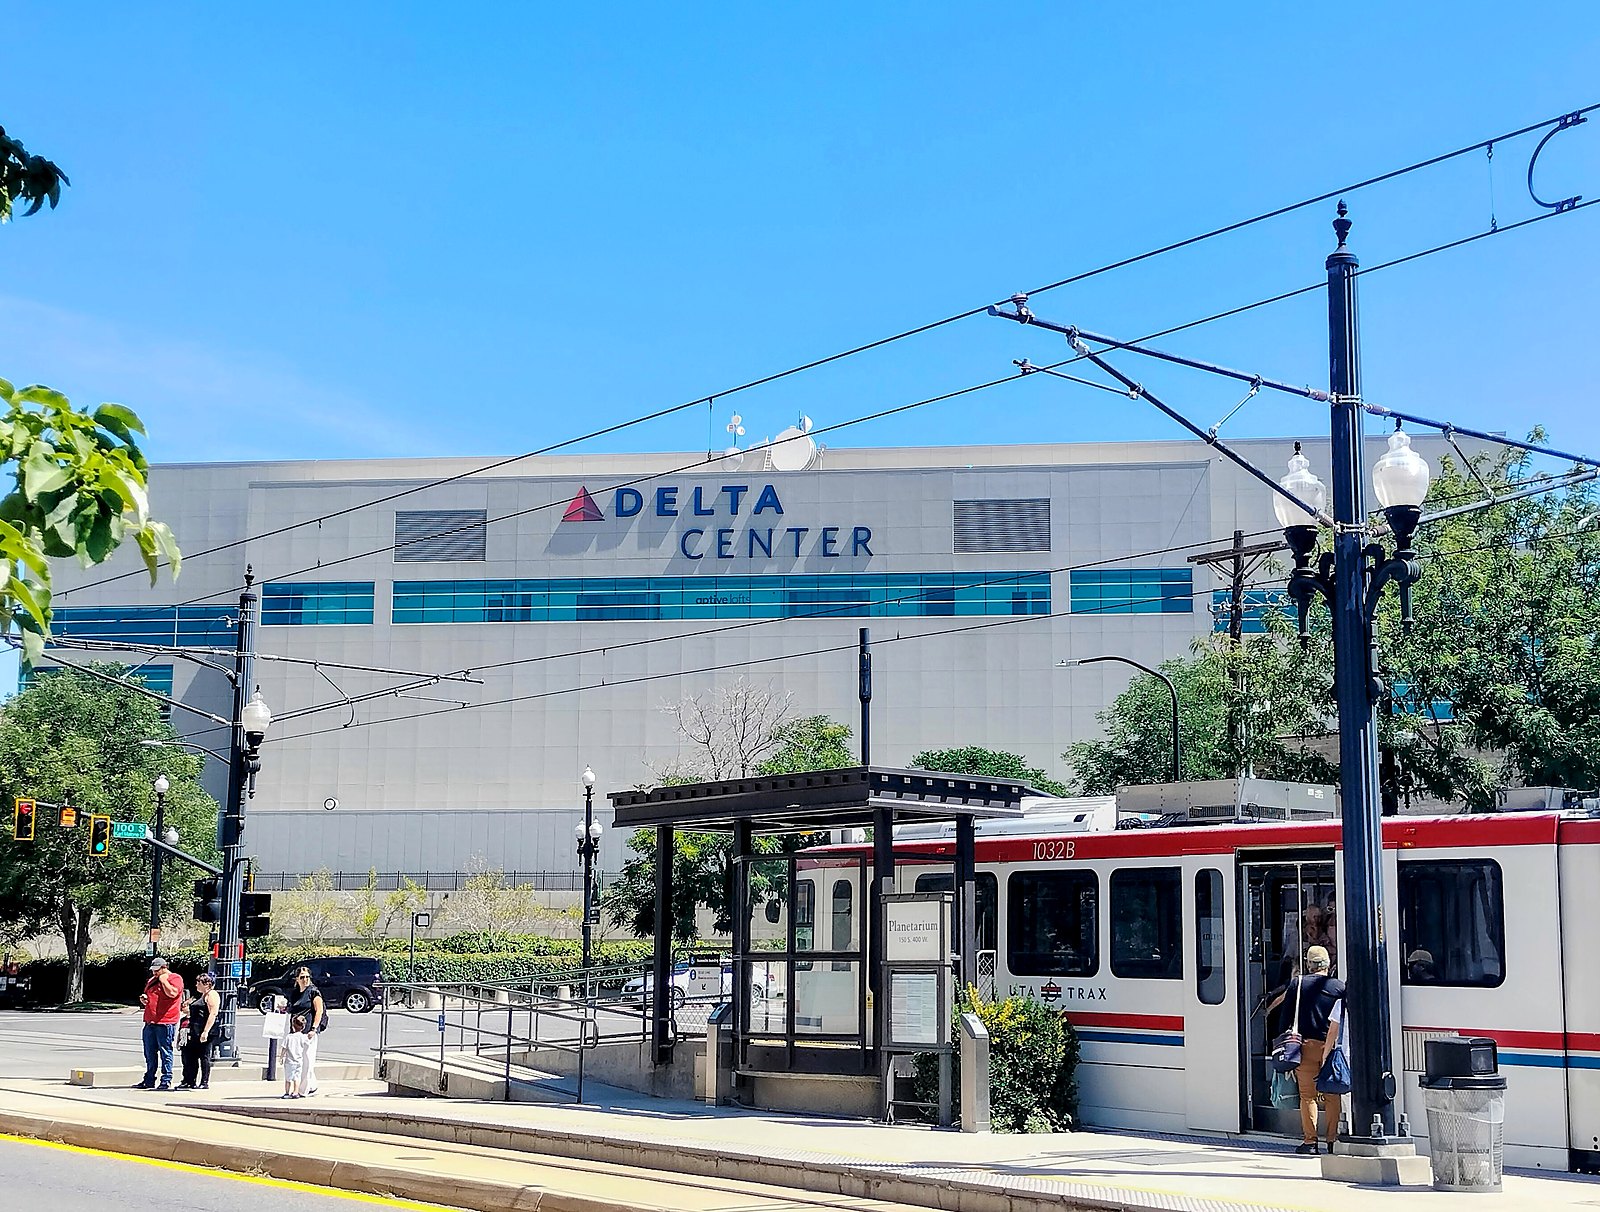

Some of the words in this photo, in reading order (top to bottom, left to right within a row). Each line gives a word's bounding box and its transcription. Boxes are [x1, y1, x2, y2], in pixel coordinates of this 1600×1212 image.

[615, 484, 784, 518] DELTA
[681, 526, 874, 560] CENTER
[116, 824, 134, 832] 100
[138, 824, 144, 832] S
[1033, 841, 1075, 860] 1032B
[889, 920, 938, 931] Planetarium
[1009, 984, 1035, 998] UTA
[1067, 986, 1107, 1000] TRAX
